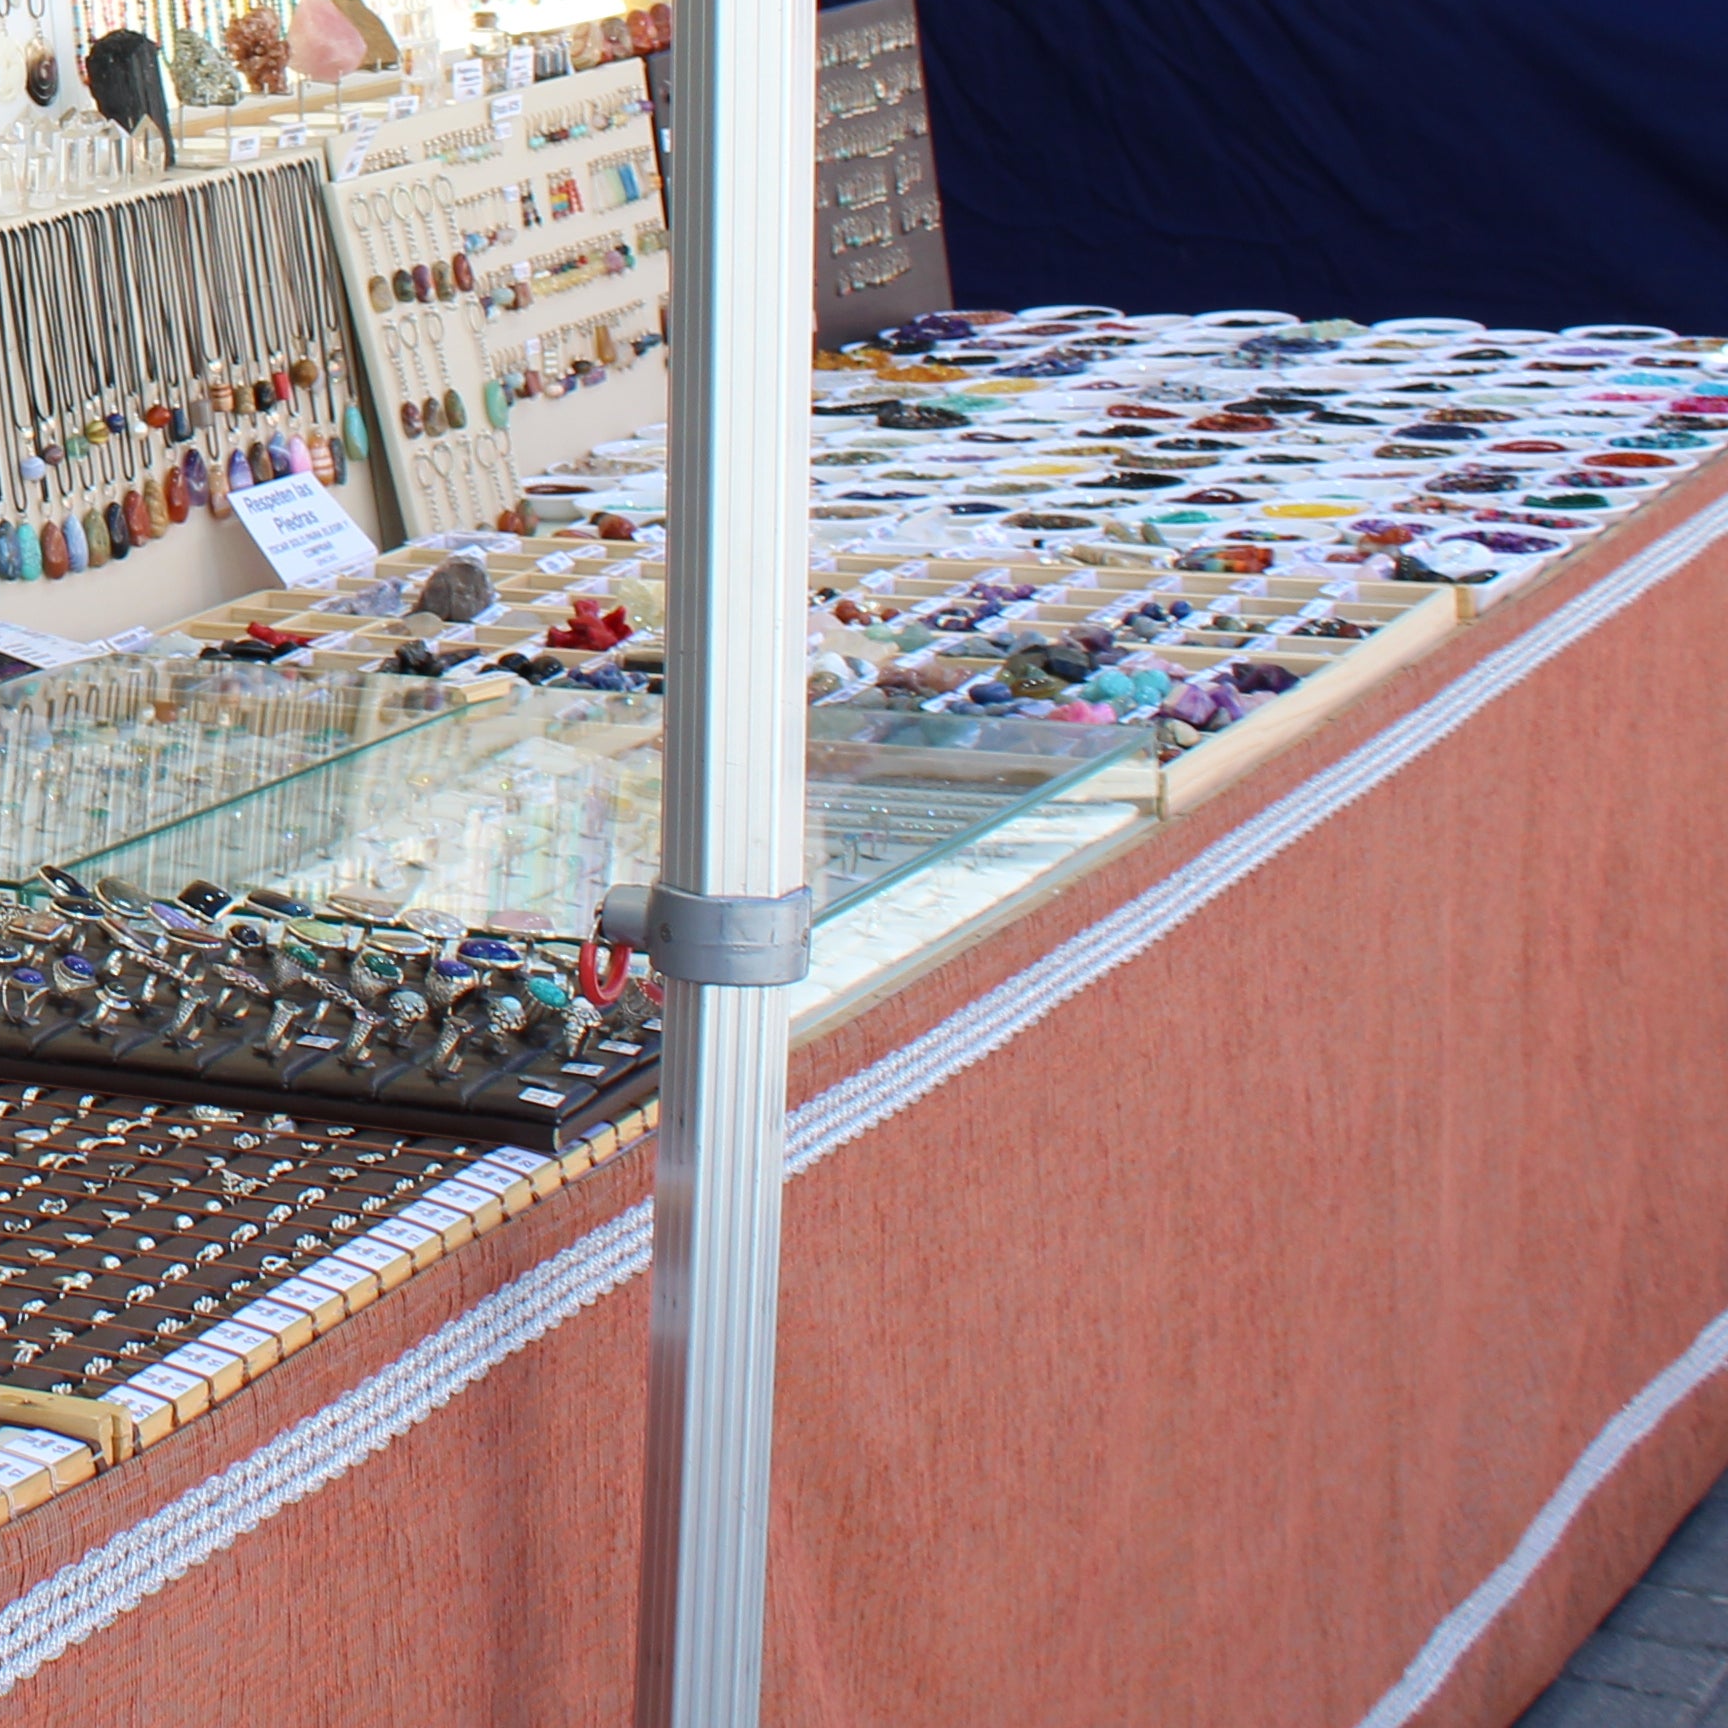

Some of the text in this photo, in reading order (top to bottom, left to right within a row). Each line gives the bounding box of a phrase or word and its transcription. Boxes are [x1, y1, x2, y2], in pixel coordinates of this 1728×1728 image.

[243, 482, 314, 515] Respeten las
[273, 510, 319, 534] Piedras
